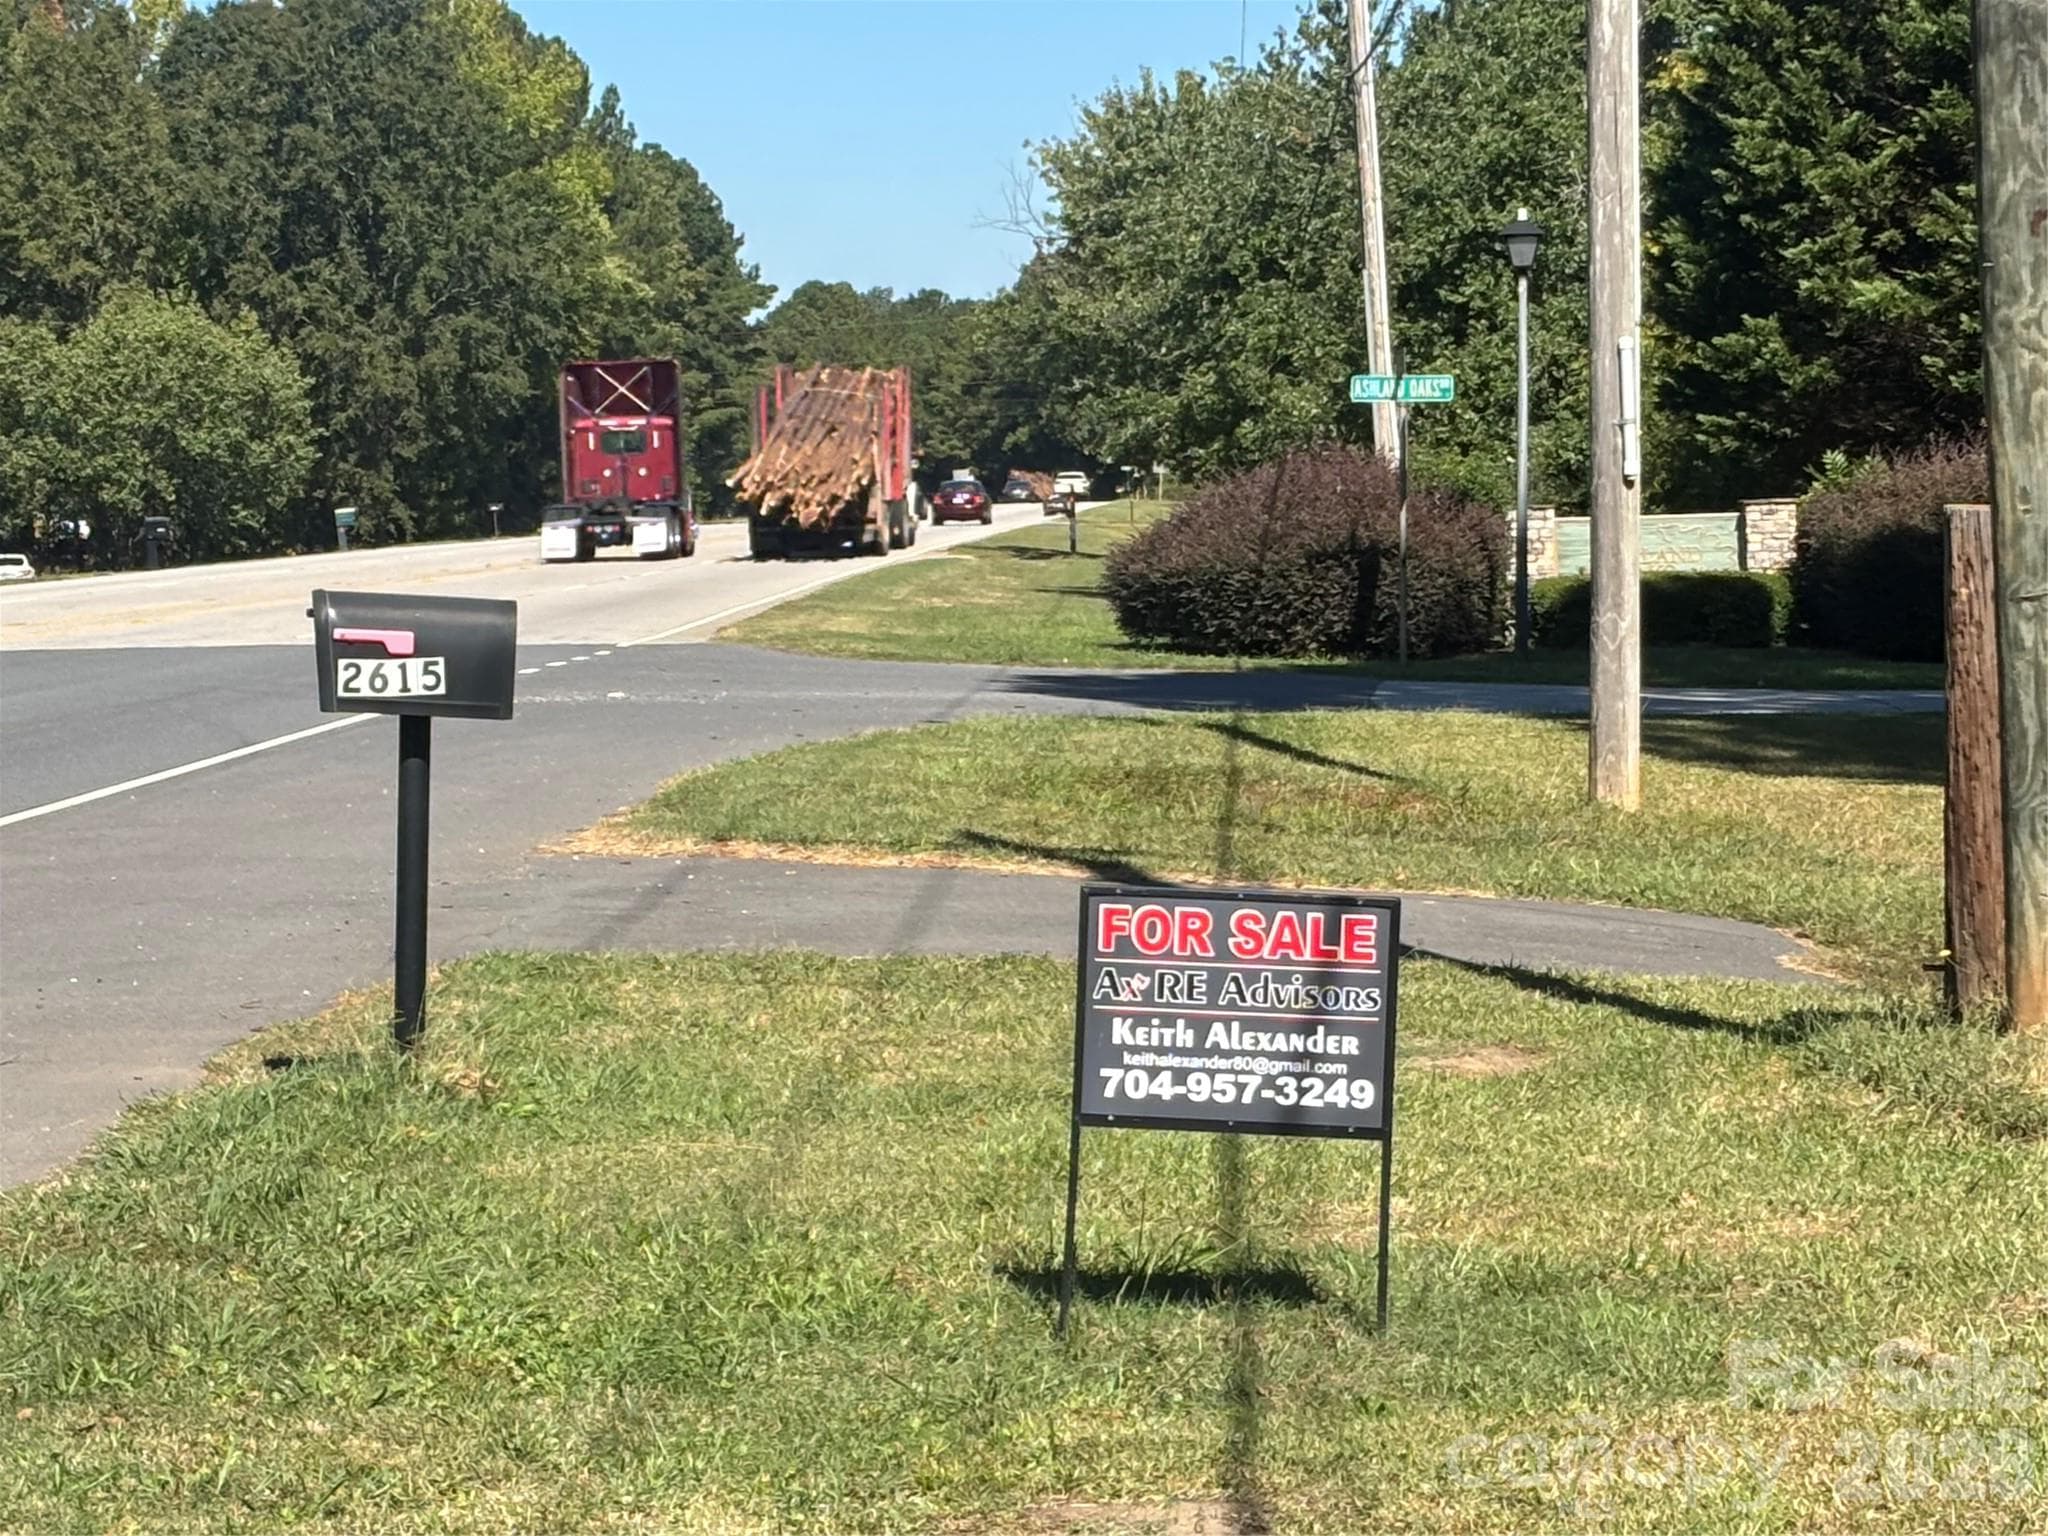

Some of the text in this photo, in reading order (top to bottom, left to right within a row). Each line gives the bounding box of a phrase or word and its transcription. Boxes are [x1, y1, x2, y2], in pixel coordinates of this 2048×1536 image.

[1410, 379, 1440, 397] OAKS
[342, 660, 442, 694] 2615
[1098, 903, 1378, 963] FOR SALE
[1154, 969, 1207, 1004] RE
[1218, 972, 1381, 1011] Advisors
[1112, 1017, 1359, 1055] Keith Alexander
[1123, 1051, 1347, 1076] keithalexander80@gmail.com
[1099, 1068, 1375, 1110] 704-957-3249
